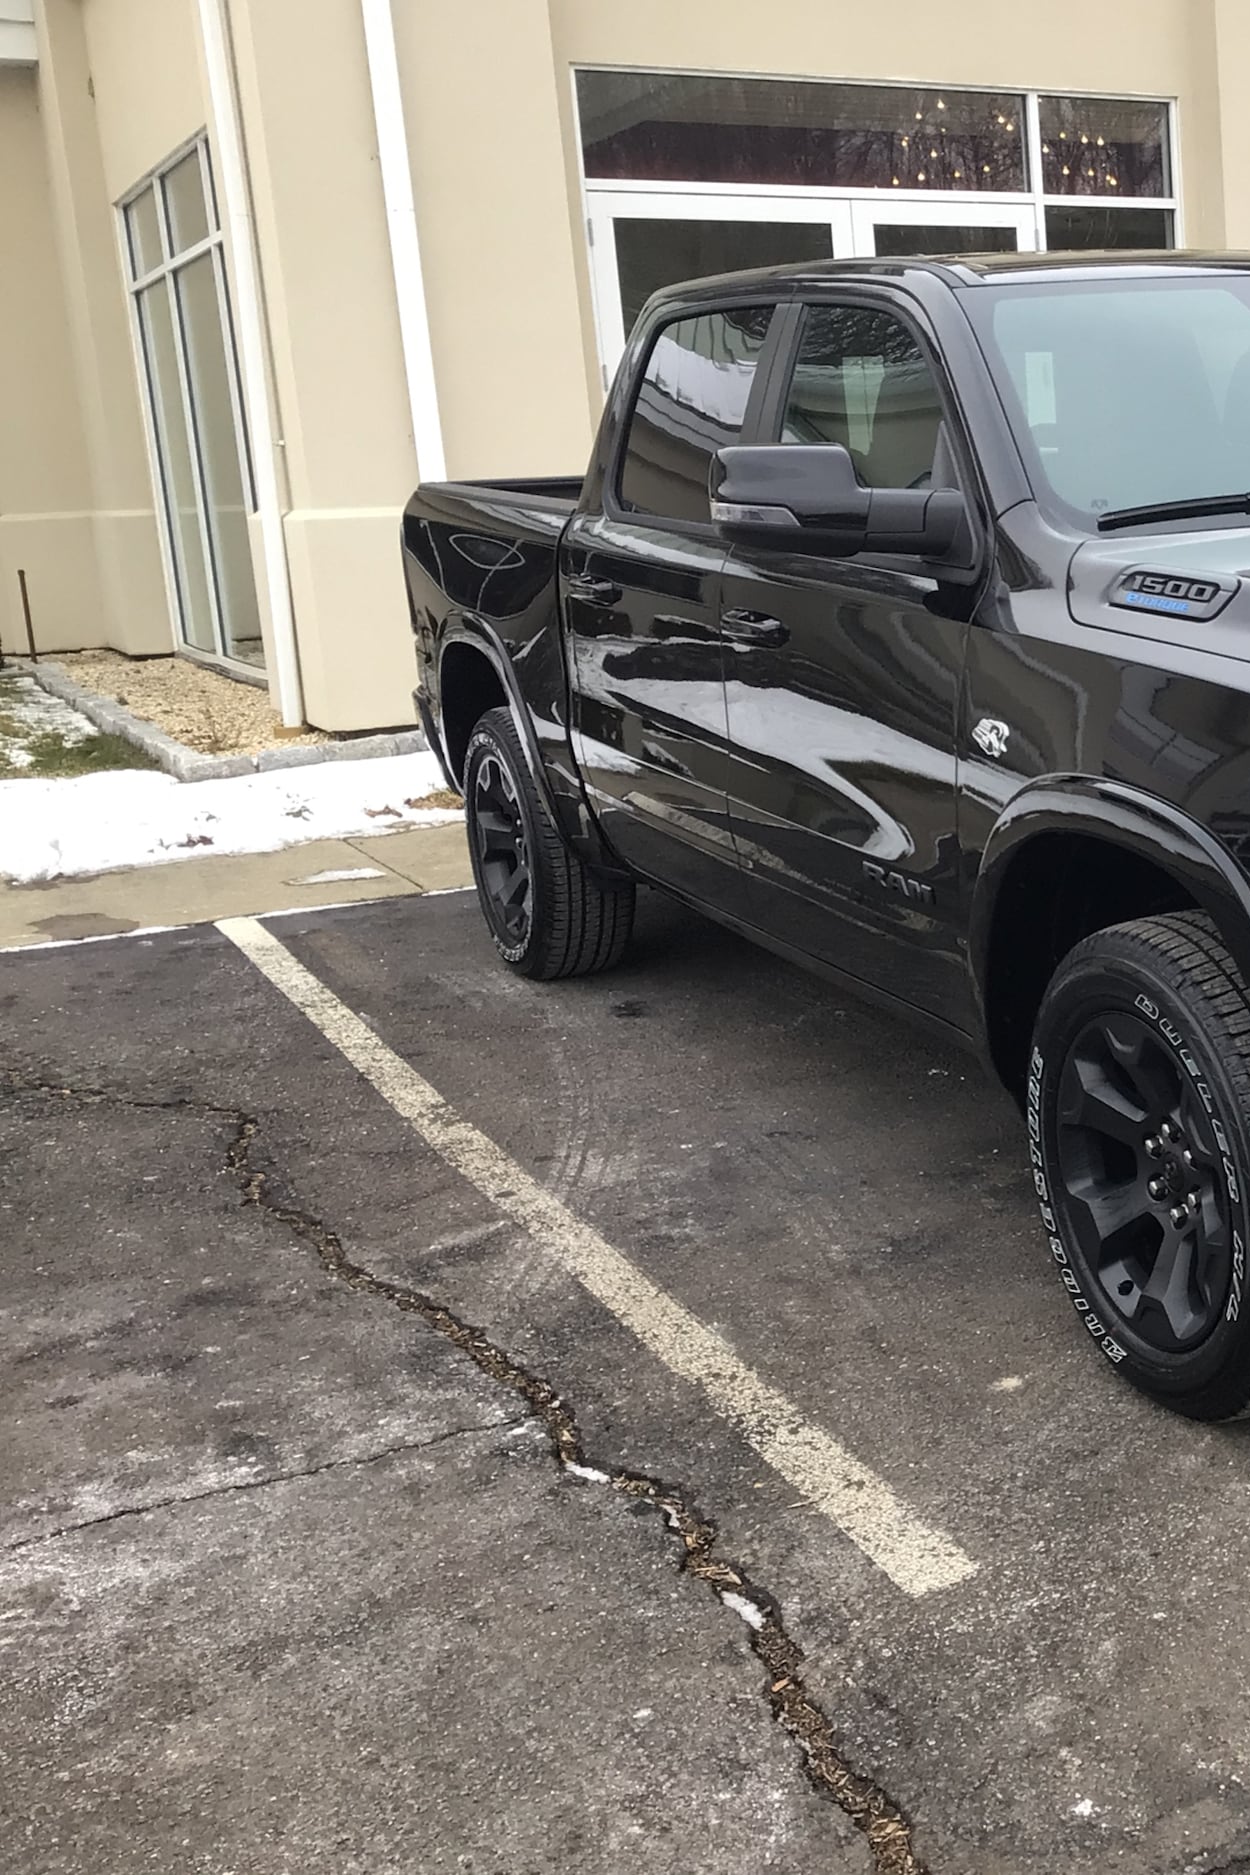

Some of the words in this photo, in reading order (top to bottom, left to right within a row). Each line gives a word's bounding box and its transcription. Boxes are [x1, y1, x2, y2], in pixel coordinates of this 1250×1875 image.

[1133, 574, 1215, 601] 1500
[862, 860, 937, 904] RAM
[1134, 994, 1239, 1203] DUELER
[1026, 1047, 1128, 1363] BRIDGESTONE
